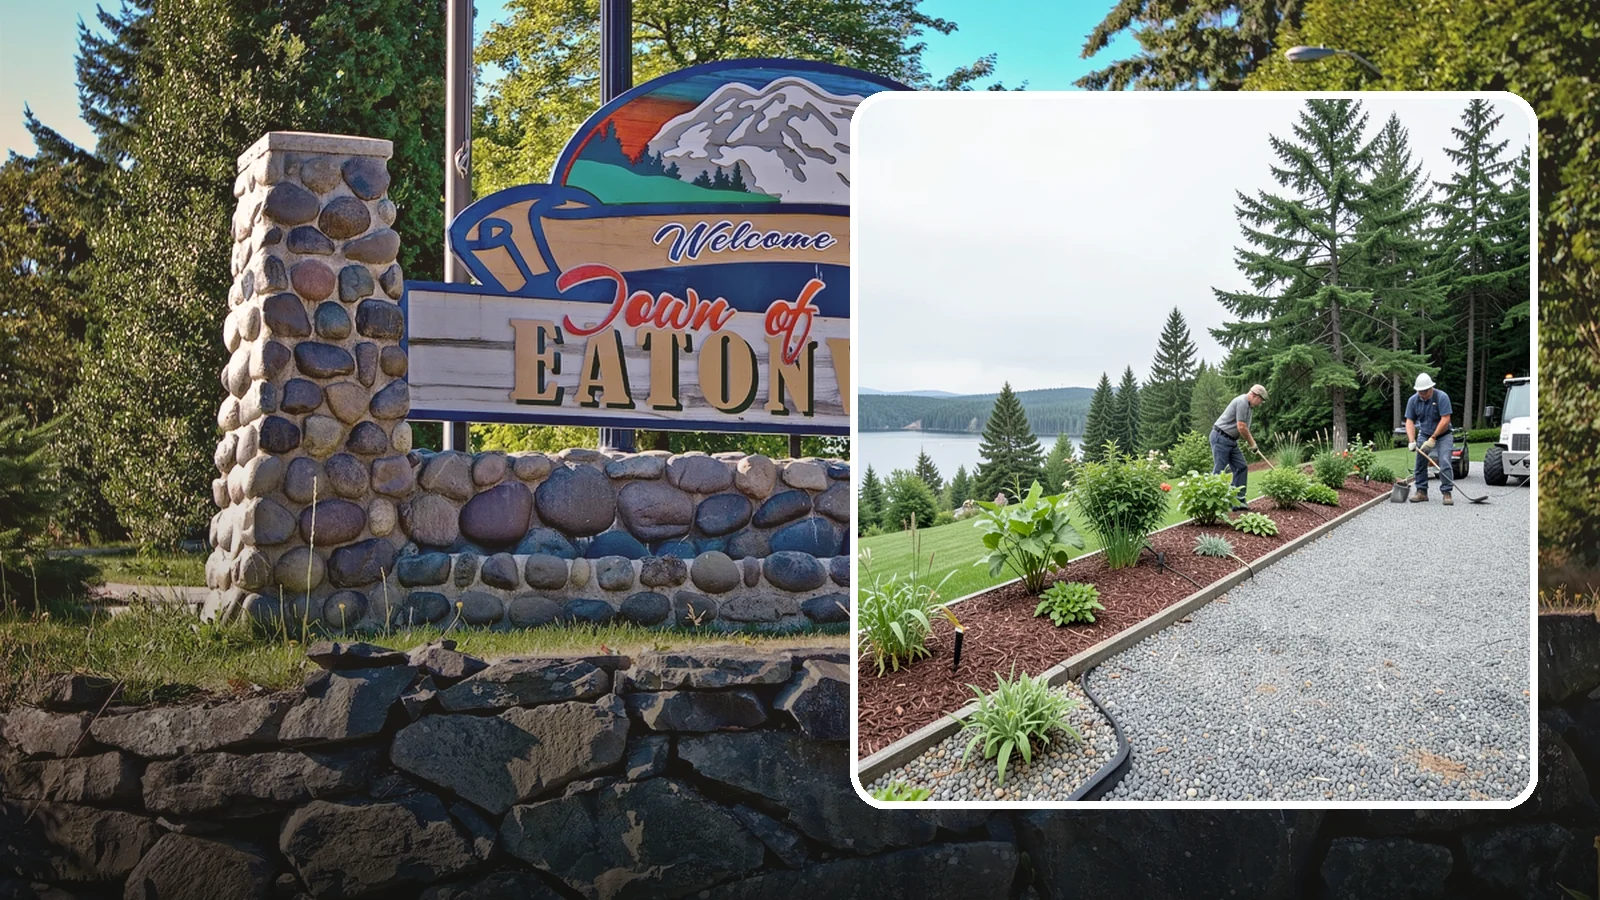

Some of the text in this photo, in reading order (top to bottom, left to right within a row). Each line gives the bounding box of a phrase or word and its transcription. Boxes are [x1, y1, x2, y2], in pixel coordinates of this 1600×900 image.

[652, 220, 837, 263] Welcome
[556, 263, 826, 365] Town of
